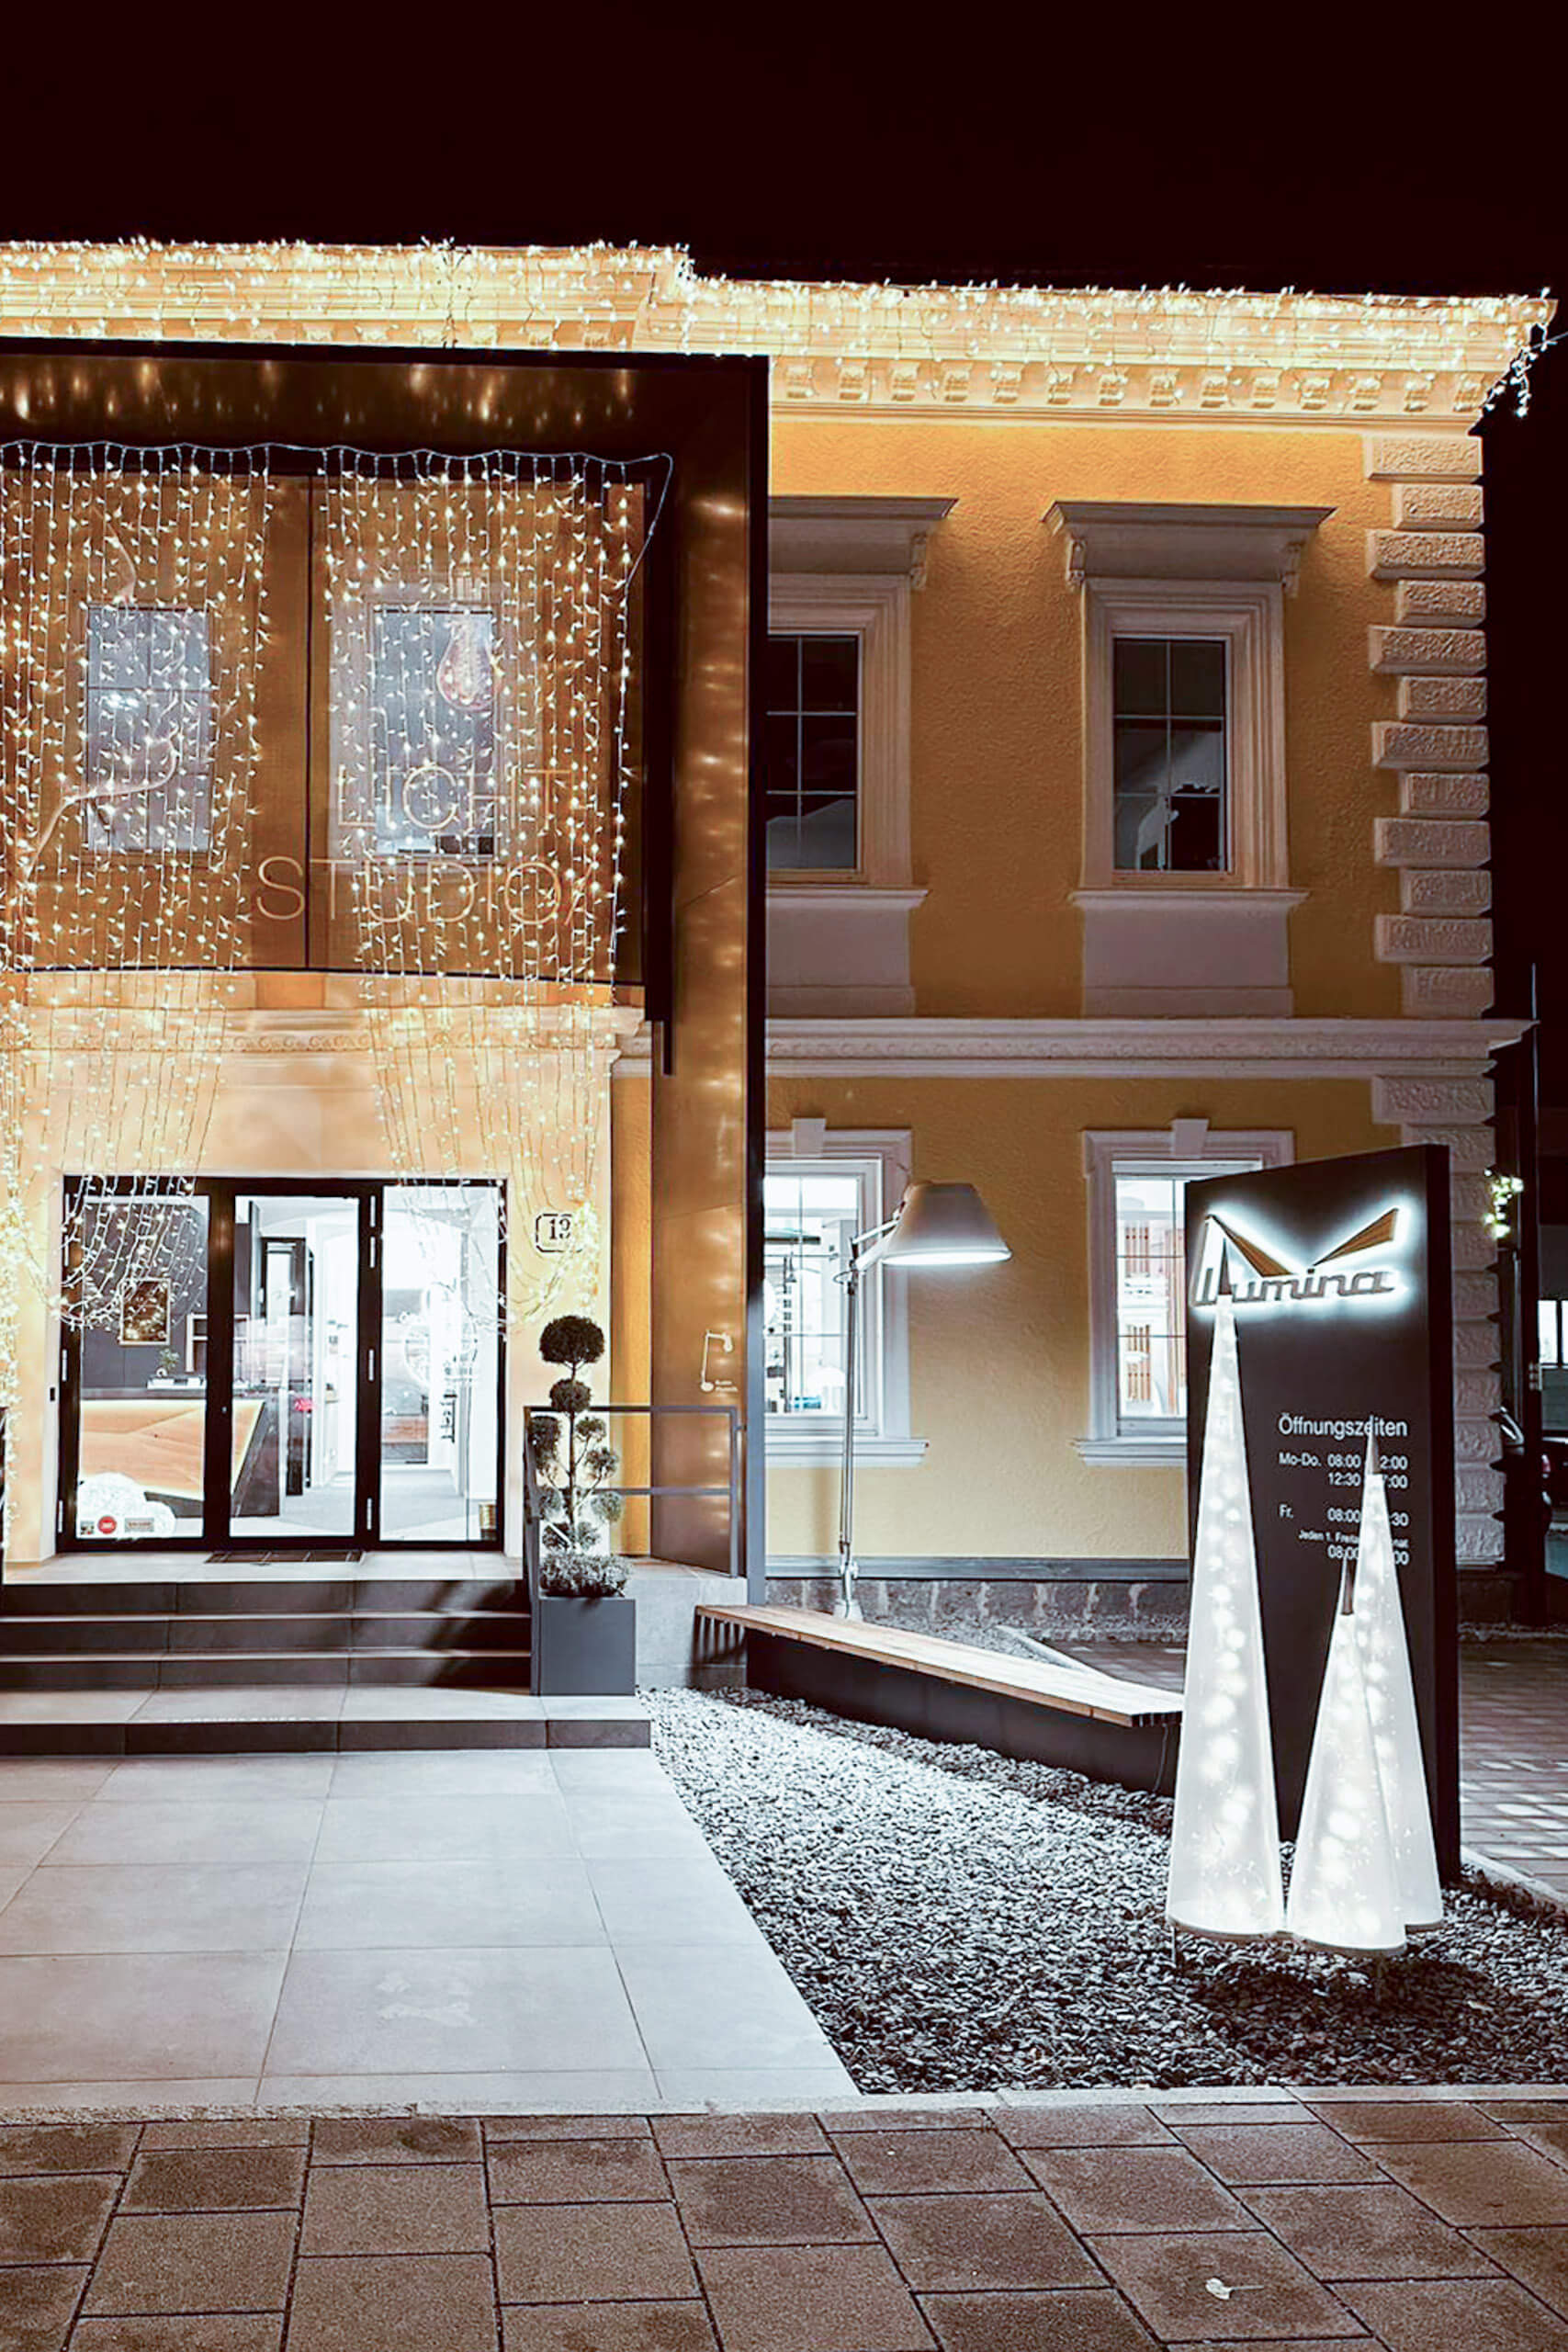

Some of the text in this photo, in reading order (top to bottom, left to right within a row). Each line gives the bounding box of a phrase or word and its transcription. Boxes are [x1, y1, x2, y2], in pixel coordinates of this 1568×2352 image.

[1278, 1412, 1408, 1441] Öffnungszeiten
[1278, 1453, 1408, 1470] Mo-Do. 08:00 2:00
[1327, 1472, 1361, 1487] 12:30
[1279, 1503, 1361, 1523] Fr. 08:00
